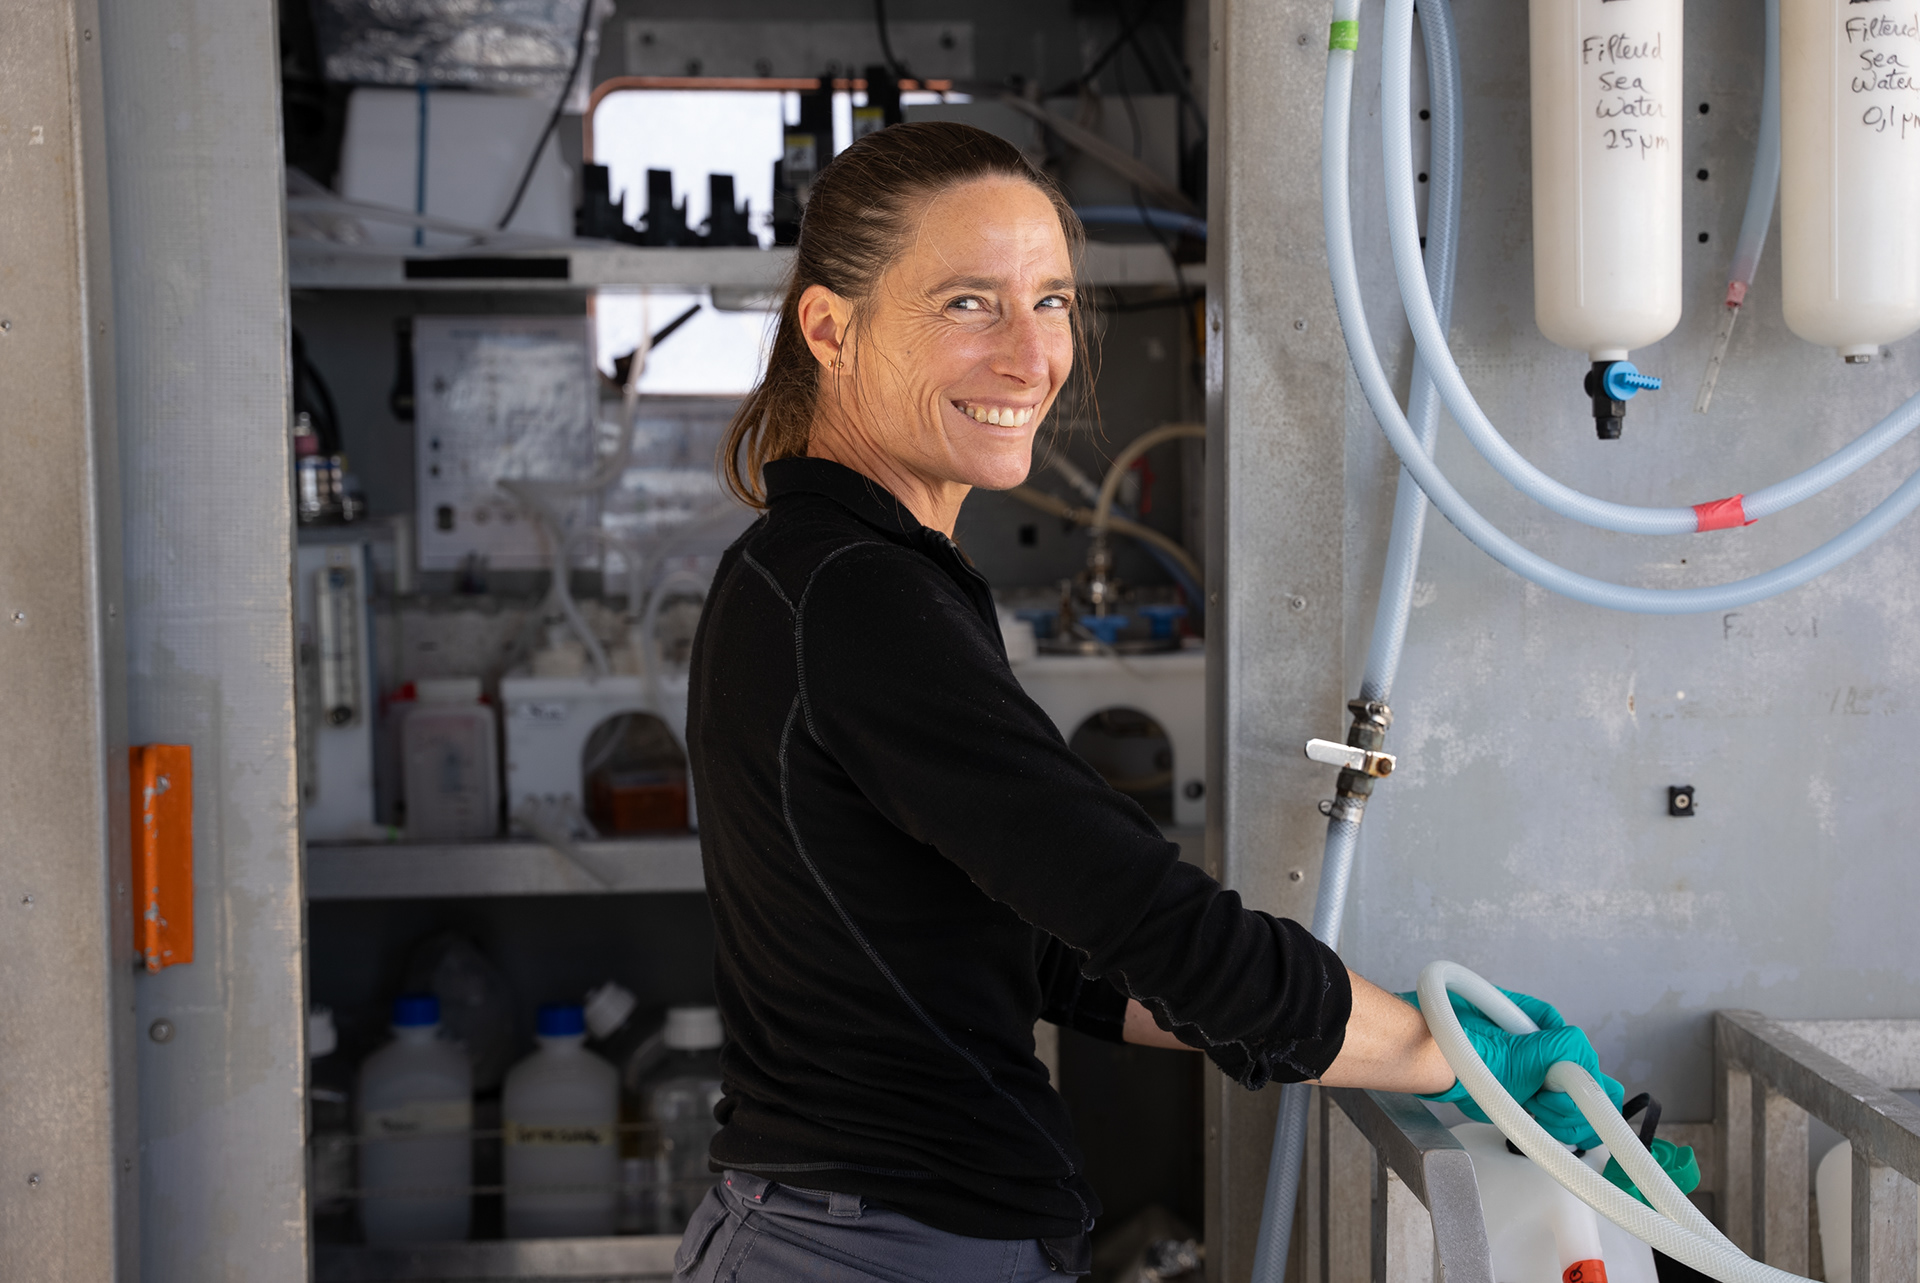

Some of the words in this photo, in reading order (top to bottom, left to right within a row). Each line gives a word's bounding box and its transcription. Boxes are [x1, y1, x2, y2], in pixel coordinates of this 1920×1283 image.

[1860, 49, 1909, 70] Sea
[1599, 71, 1652, 94] Sea
[1852, 68, 1920, 93] Water
[1596, 95, 1666, 118] Water
